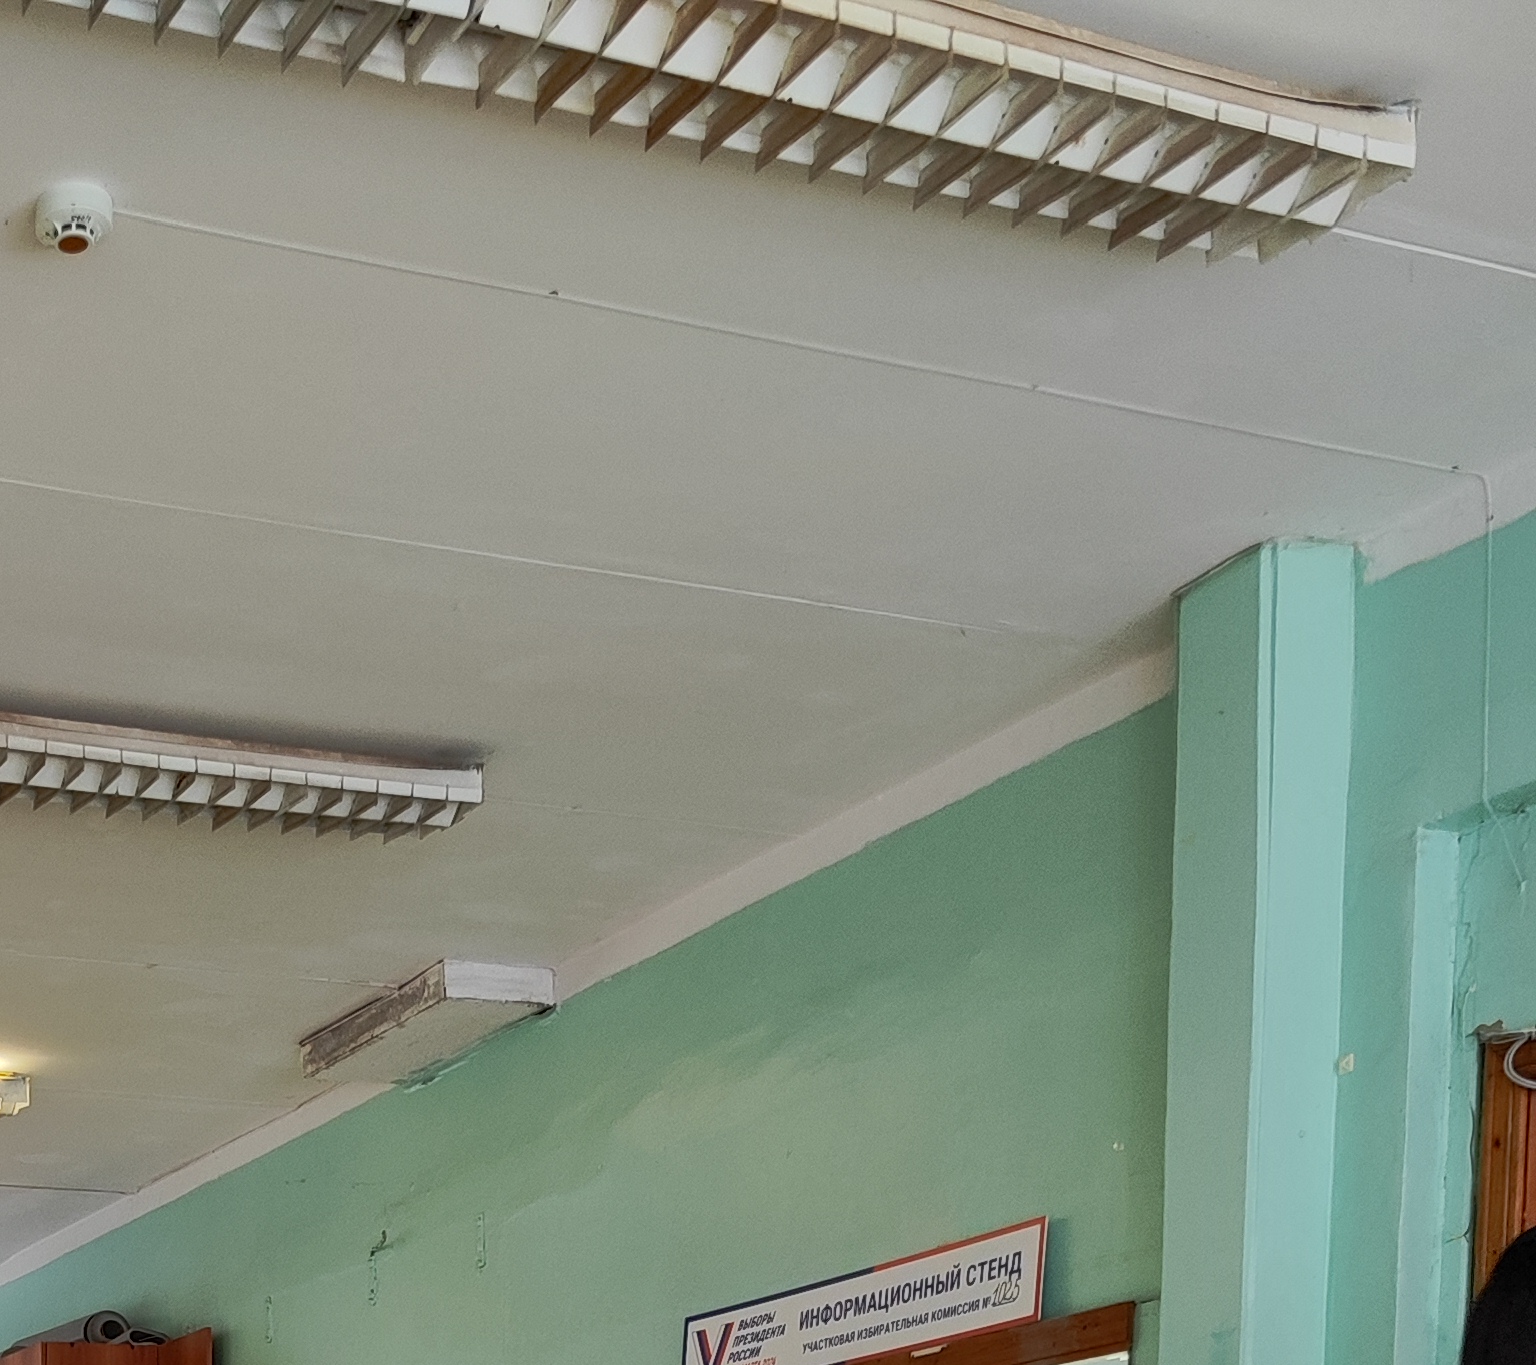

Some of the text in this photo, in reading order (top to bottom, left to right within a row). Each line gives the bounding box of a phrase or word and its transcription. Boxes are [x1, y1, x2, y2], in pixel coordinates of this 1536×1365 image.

[799, 1251, 1022, 1331] ИНФОРМАЦИОННЫЙ СТЕНД
[991, 1278, 1021, 1307] 1025
[737, 1311, 776, 1332] ВЫБОРЫ
[803, 1330, 855, 1354] УЧАСТКОВАЯ
[857, 1312, 929, 1340] ИЗБИРАТЕЛЬНАЯ
[931, 1299, 980, 1322] КОМИССИЯ
[732, 1324, 786, 1348] ПРЕЗИДЕНТА
[727, 1345, 762, 1364] РОССИИ
